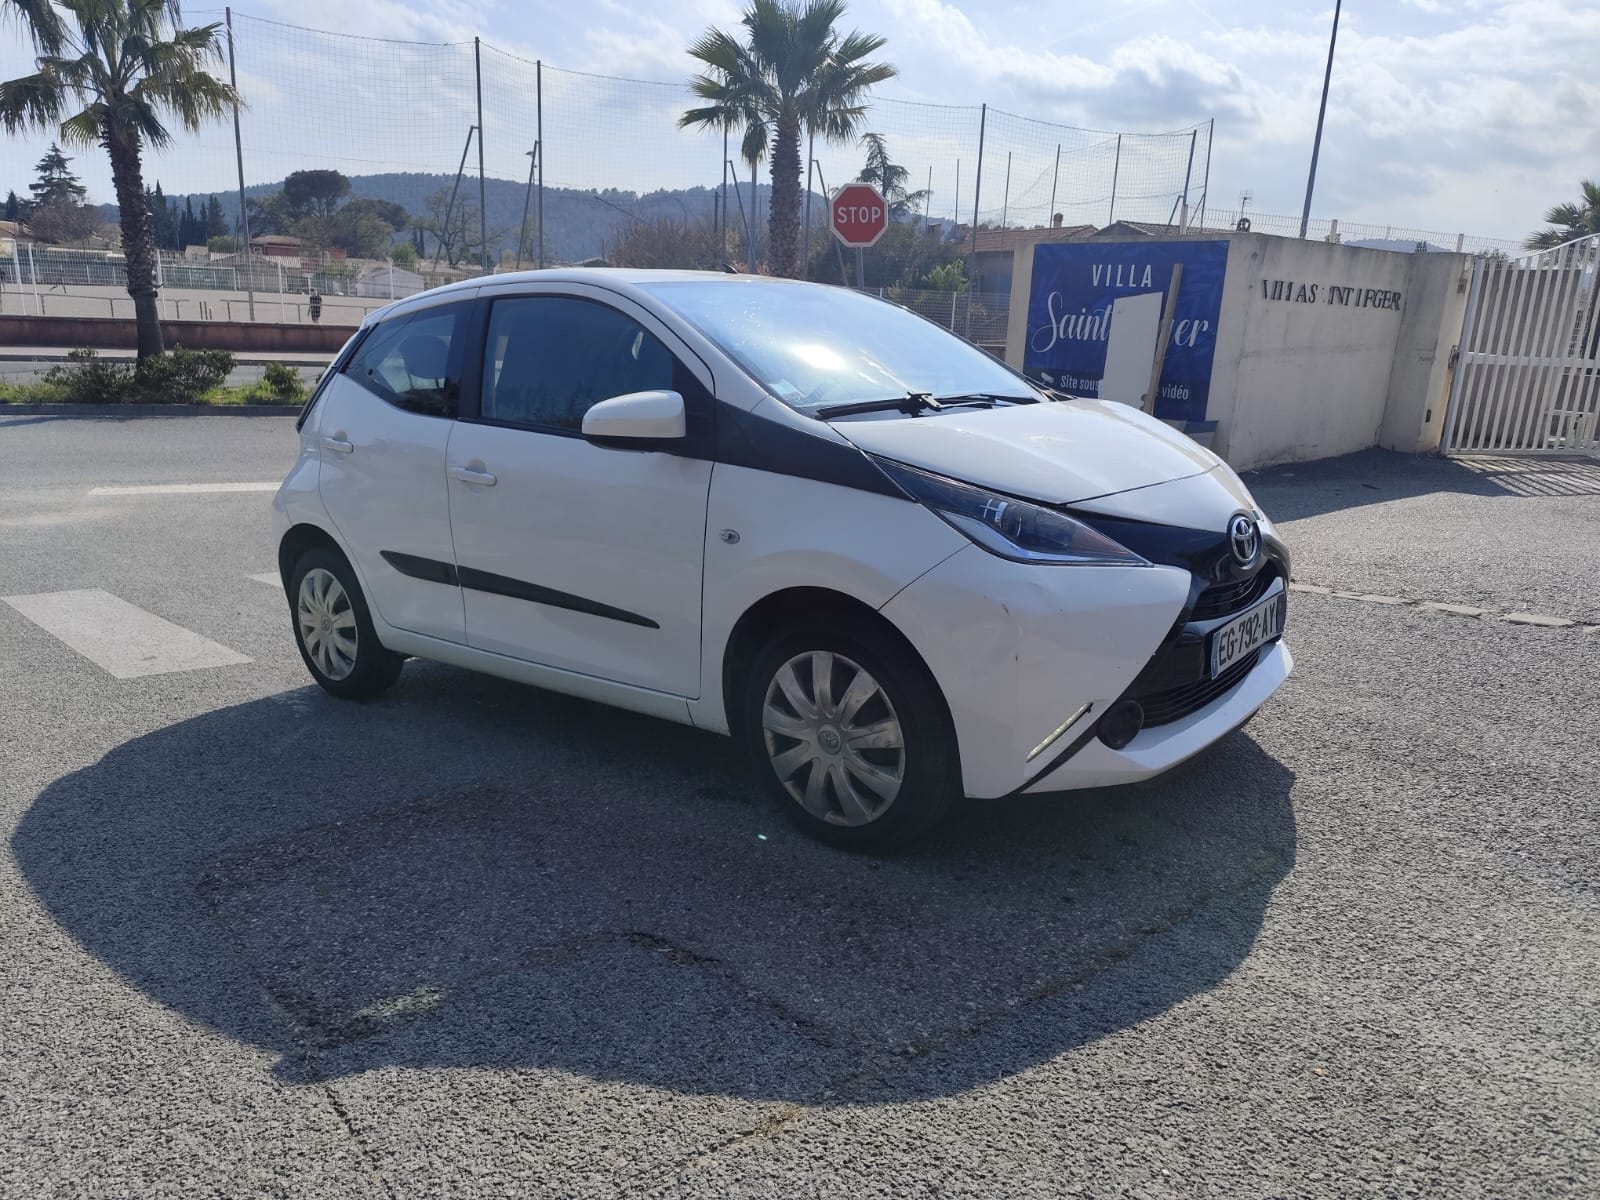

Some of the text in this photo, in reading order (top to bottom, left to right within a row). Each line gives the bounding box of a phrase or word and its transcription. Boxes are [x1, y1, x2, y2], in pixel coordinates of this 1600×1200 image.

[837, 206, 881, 224] STOP
[1092, 264, 1152, 287] VILLA
[1031, 291, 1113, 352] Saint
[1060, 375, 1078, 389] Site
[1162, 383, 1189, 400] vidéo
